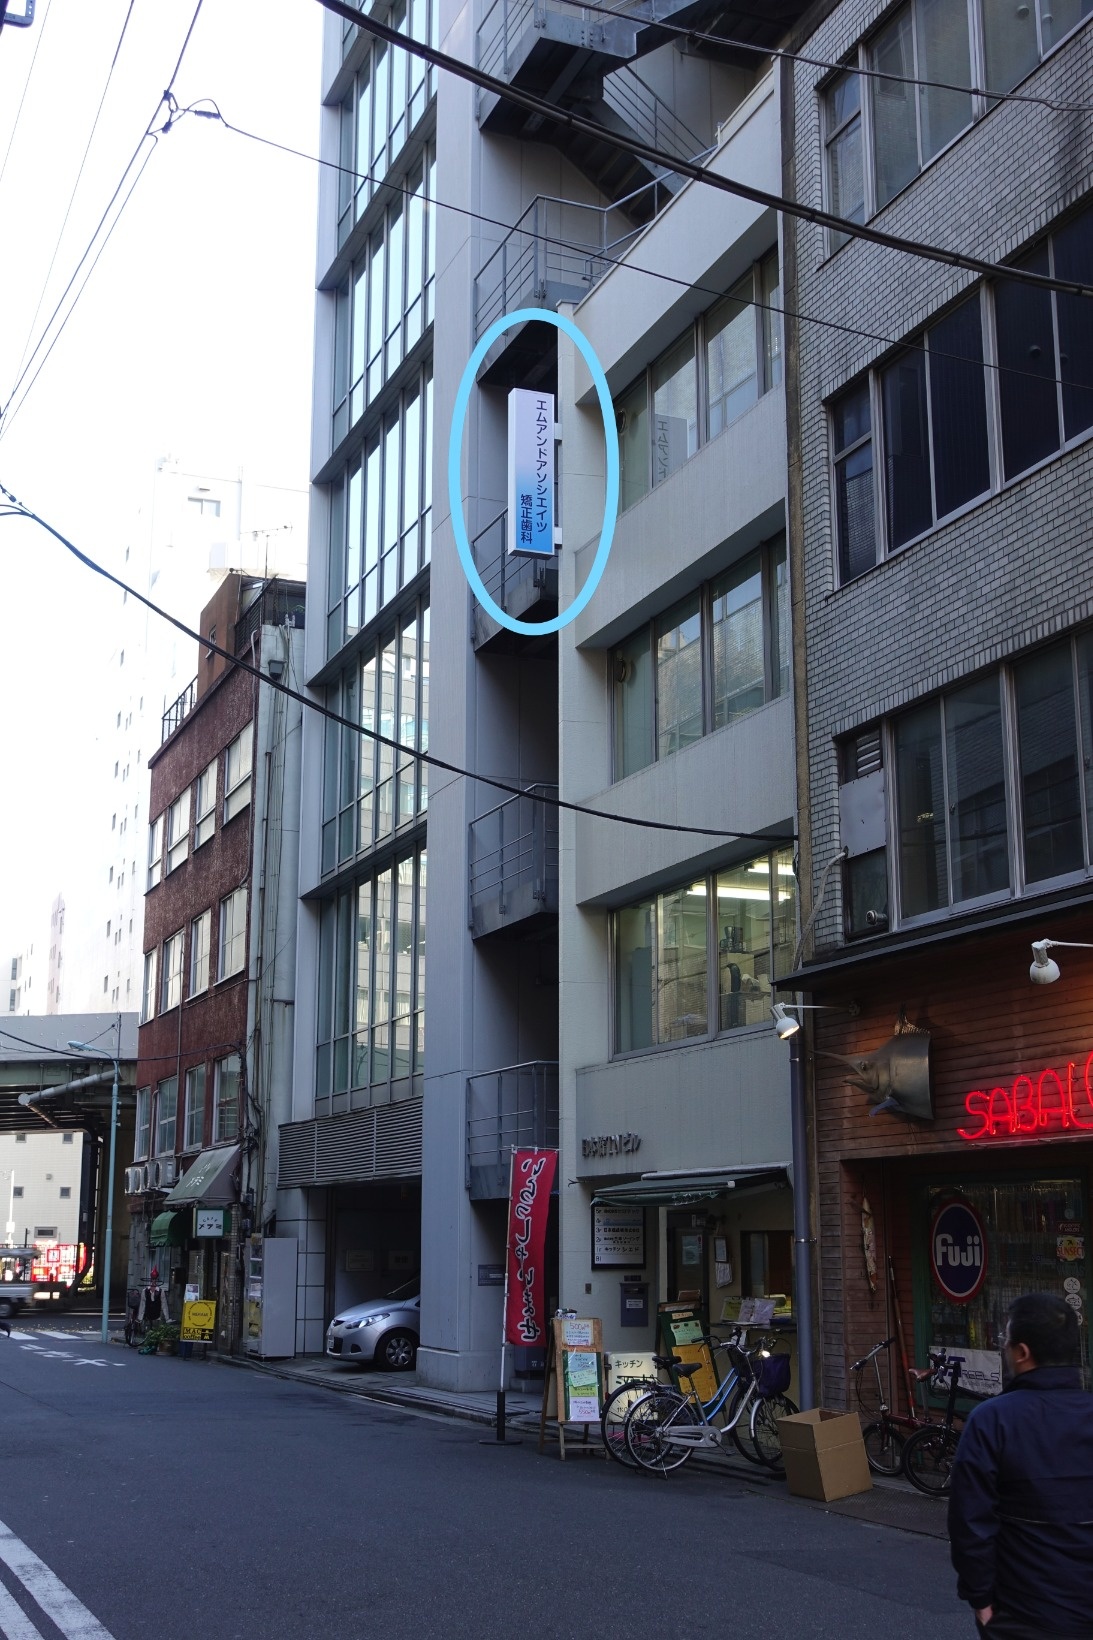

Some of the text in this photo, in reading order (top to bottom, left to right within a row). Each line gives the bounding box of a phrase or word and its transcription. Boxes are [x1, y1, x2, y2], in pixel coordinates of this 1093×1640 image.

[536, 400, 547, 533] エムアンドアソシエイツ
[521, 493, 533, 545] 矯正歯科
[615, 1359, 644, 1369] キッチン
